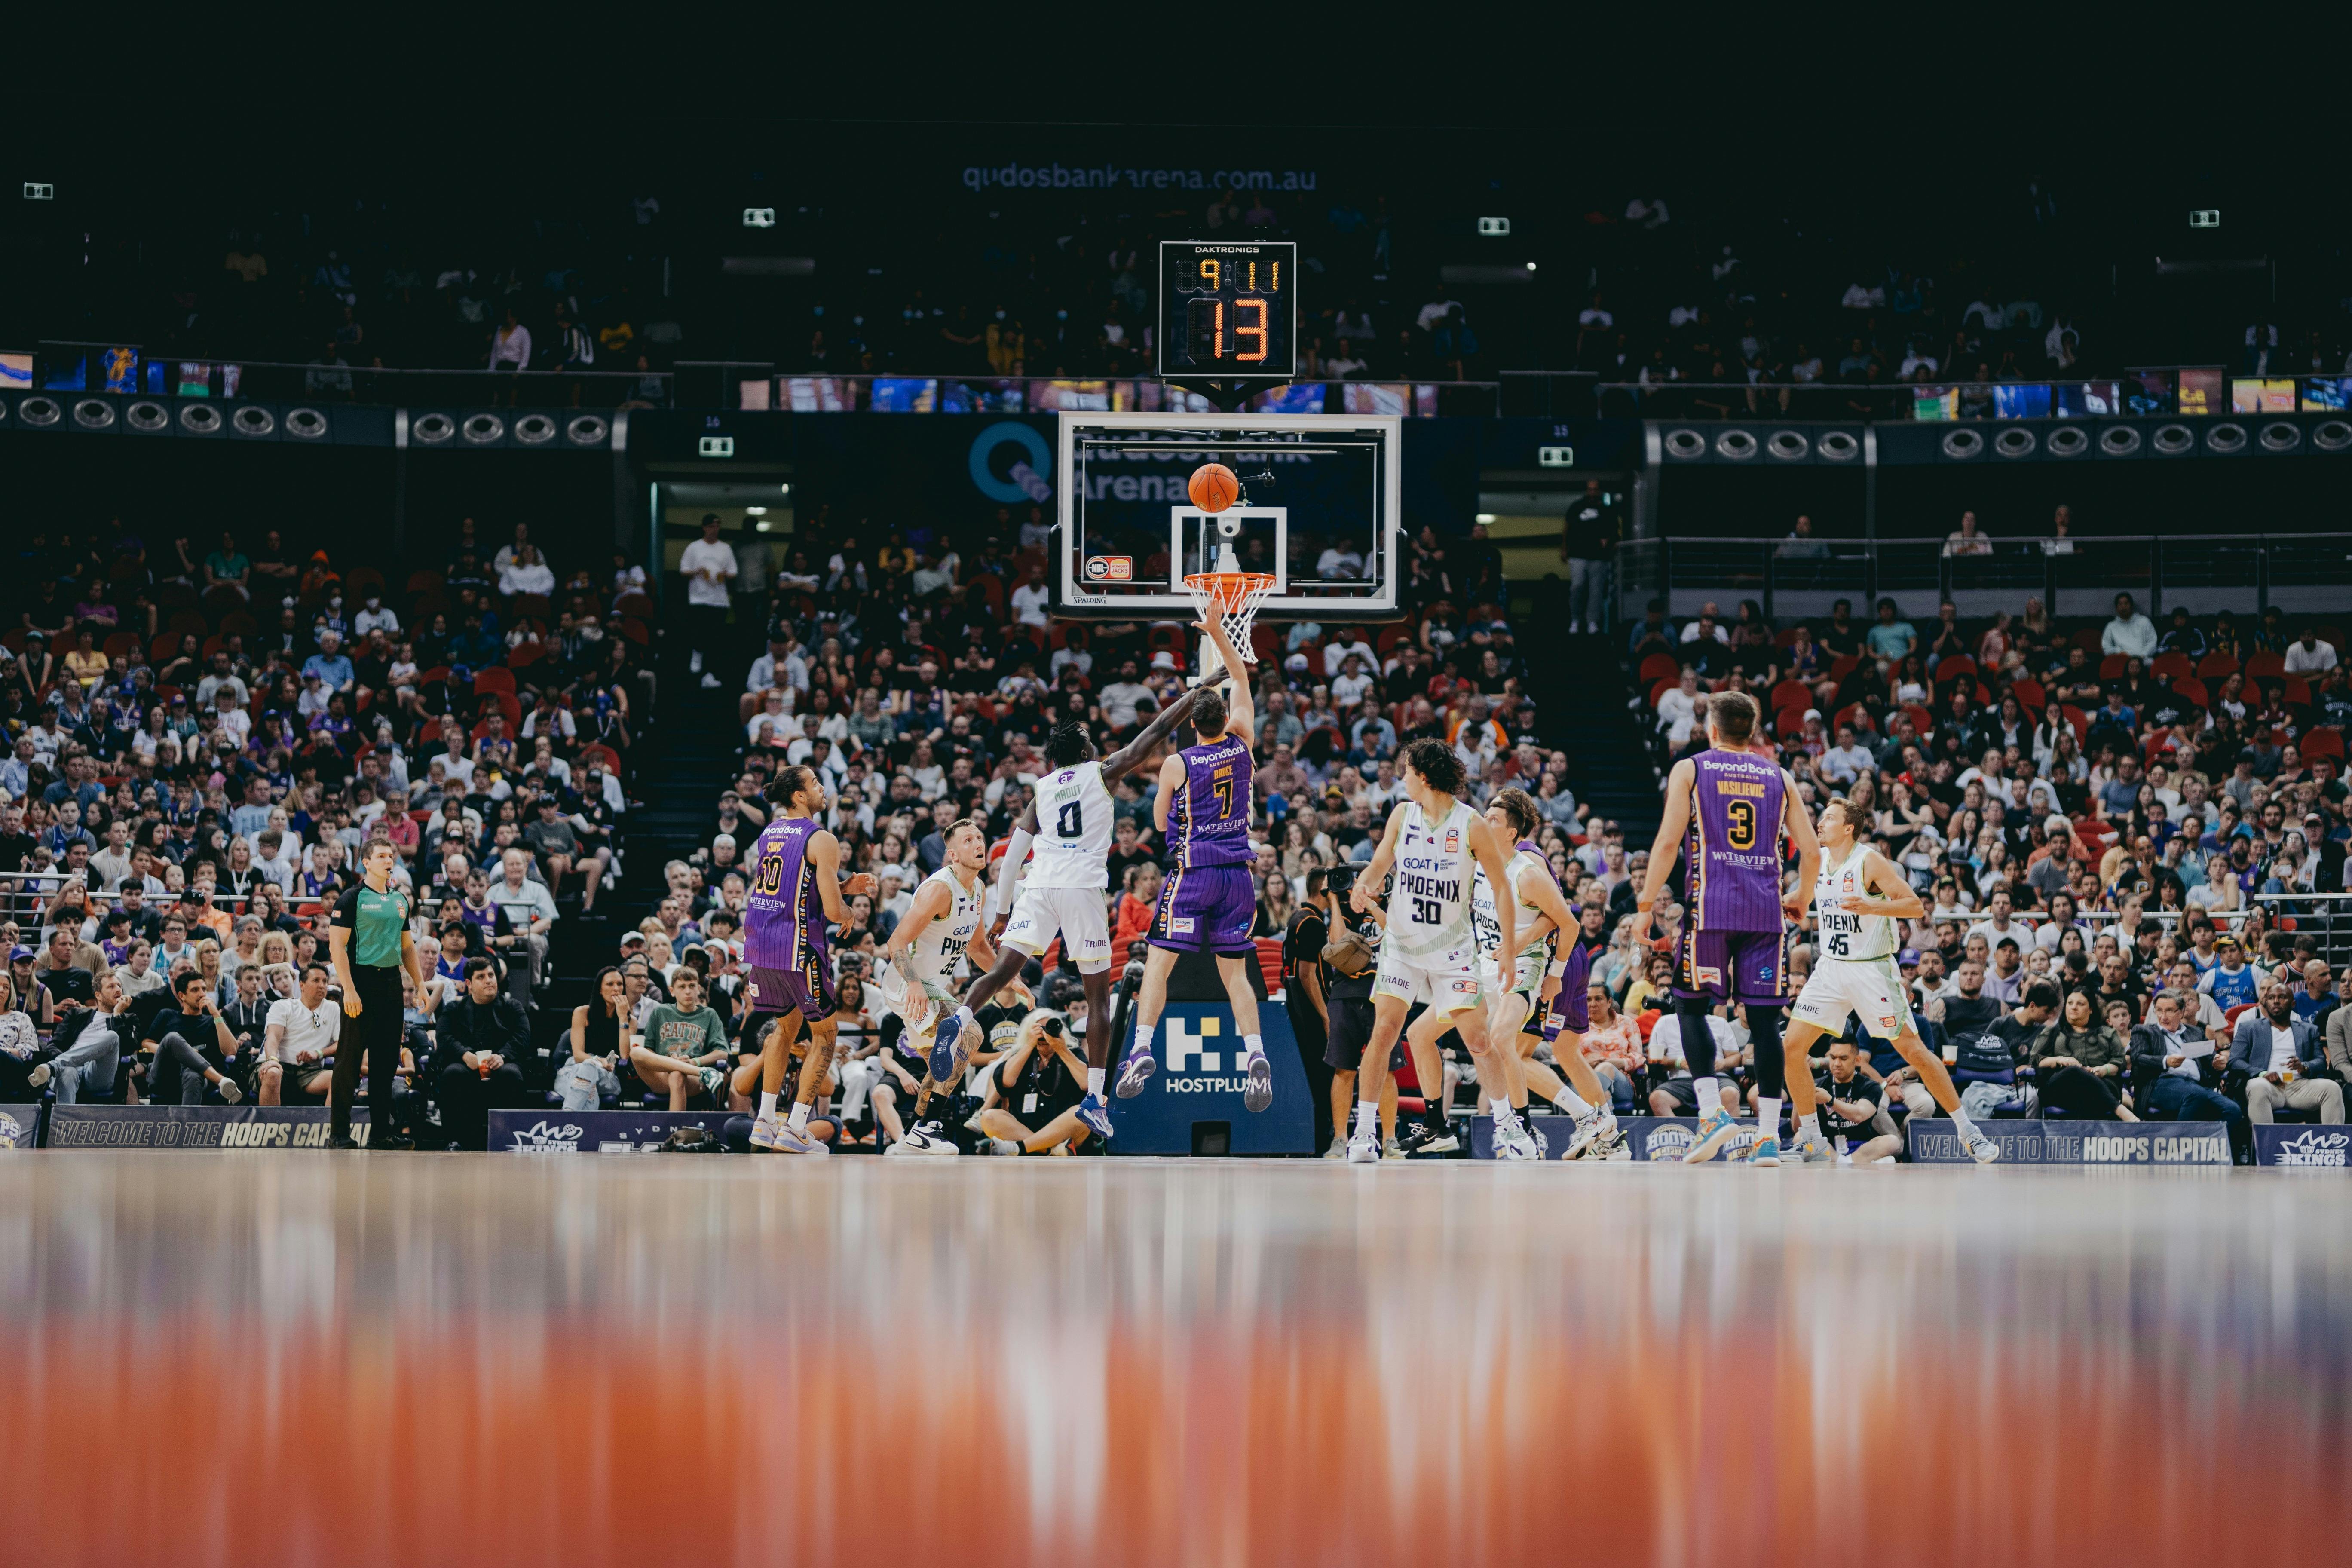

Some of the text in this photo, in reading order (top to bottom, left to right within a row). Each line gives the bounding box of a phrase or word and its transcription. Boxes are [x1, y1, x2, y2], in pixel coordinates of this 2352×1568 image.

[962, 163, 1317, 193] qudosbankarena.com.au
[1214, 299, 1268, 361] 13
[1073, 474, 1191, 504] Arena
[1091, 563, 1105, 573] NBL
[1209, 757, 1236, 768] AUSTRALIA
[1214, 765, 1234, 780] BRUCE
[1054, 784, 1081, 802] MADUT
[1213, 778, 1233, 819] 7
[1057, 799, 1084, 839] 0
[1727, 799, 1756, 851] 3
[1403, 858, 1432, 870] GOAT
[1712, 851, 1776, 865] WATERVIEW
[756, 855, 784, 896] 10
[1400, 871, 1460, 902] PHOENIX
[750, 897, 787, 909] WATERVIEW
[1412, 897, 1442, 925] 30
[1819, 898, 1833, 907] OAT
[1008, 920, 1031, 931] GOAT
[1822, 910, 1863, 933] OENIX
[1085, 939, 1107, 948] TRADIE
[1828, 934, 1849, 956] 45
[1381, 975, 1410, 989] TRADIE
[1796, 1002, 1819, 1014] TRADIE
[989, 1026, 1019, 1043] HOOP
[54, 1121, 372, 1147] WELCOME TO THE HOOPS CAPAL
[1919, 1134, 2230, 1162] WELCME TO THE HOOPS CAPITAL
[2290, 1153, 2346, 1166] KINGS
